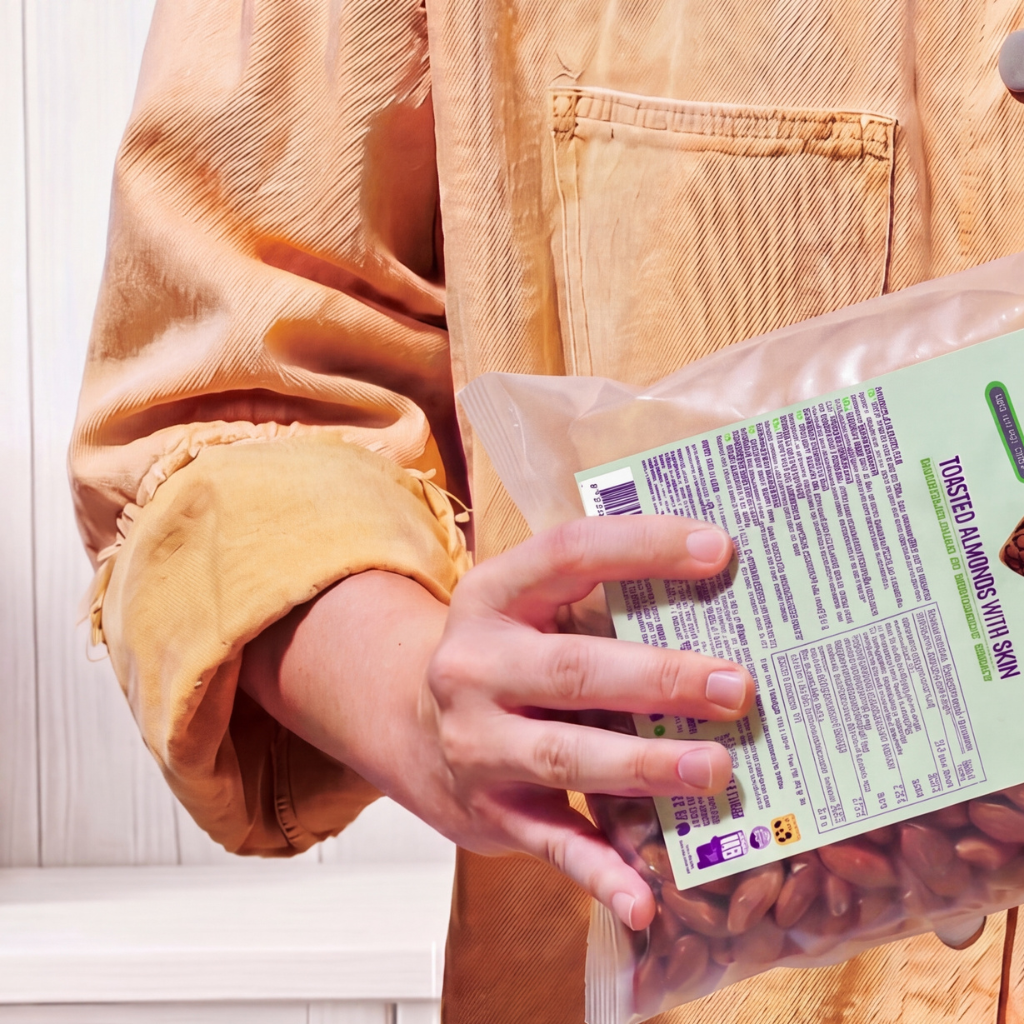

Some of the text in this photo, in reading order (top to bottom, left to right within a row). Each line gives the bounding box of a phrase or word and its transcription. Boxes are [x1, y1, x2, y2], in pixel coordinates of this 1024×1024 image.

[938, 454, 975, 525] TOASTED
[958, 527, 997, 601] ALMONDS
[981, 598, 1010, 637] WITH
[992, 638, 1021, 680] SKIN
